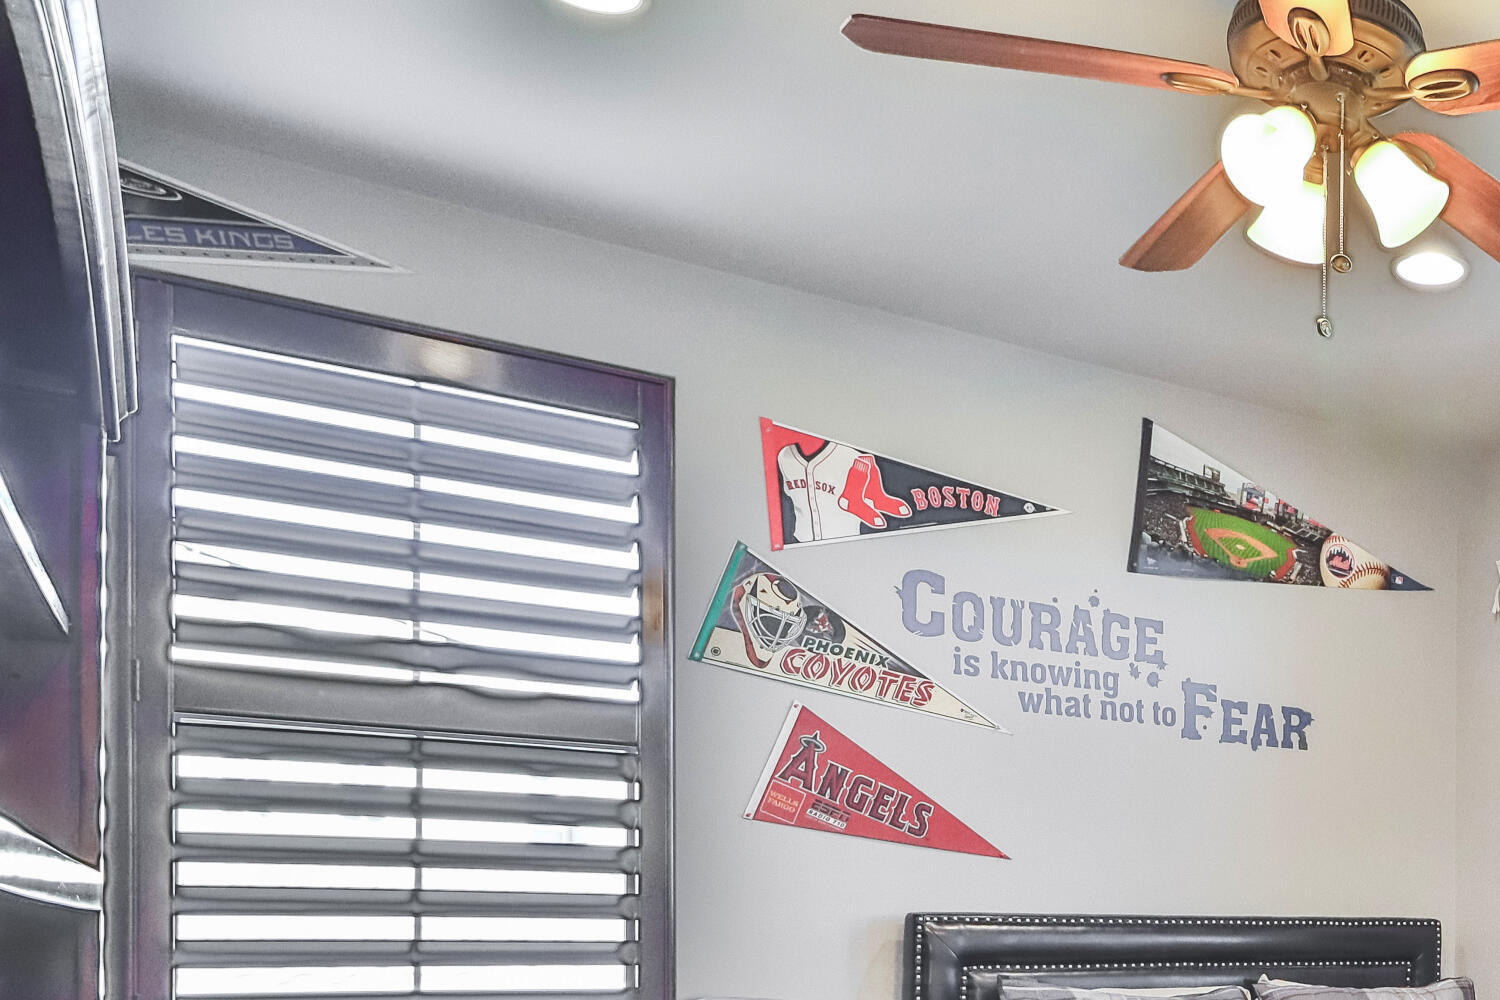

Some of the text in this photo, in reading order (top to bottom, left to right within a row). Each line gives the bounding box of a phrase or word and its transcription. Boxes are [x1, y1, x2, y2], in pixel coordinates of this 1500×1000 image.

[194, 229, 295, 250] KINGS
[785, 479, 836, 495] RED SOX
[910, 486, 1001, 517] BOSTON
[899, 569, 1166, 668] COURAGE
[801, 635, 891, 669] PHOENIX
[780, 648, 936, 707] COYOTES
[953, 646, 1120, 698] is knowing
[1017, 678, 1313, 751] what not to FEAR
[769, 790, 799, 807] WELLS
[775, 738, 935, 839] ANGELS
[767, 798, 796, 813] FARGO
[808, 809, 846, 828] RADIO 710
